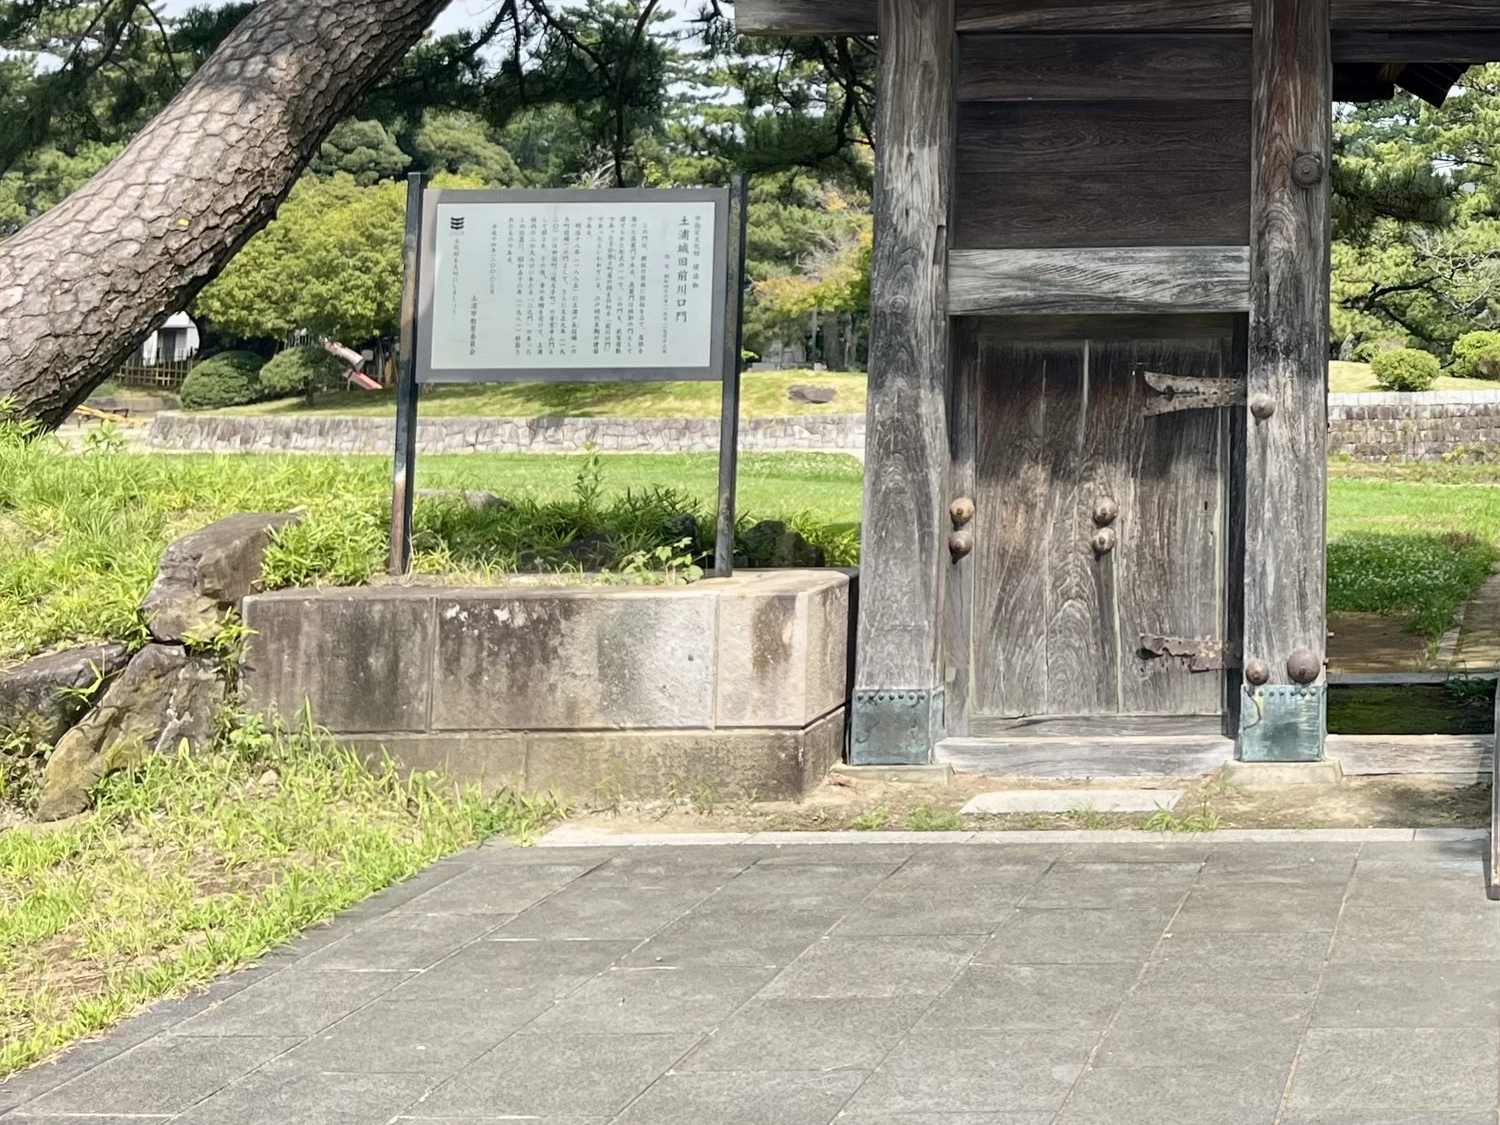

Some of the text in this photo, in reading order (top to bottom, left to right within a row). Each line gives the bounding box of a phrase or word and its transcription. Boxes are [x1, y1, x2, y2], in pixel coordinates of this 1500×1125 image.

[676, 215, 690, 323] 土浦城旧前川口門
